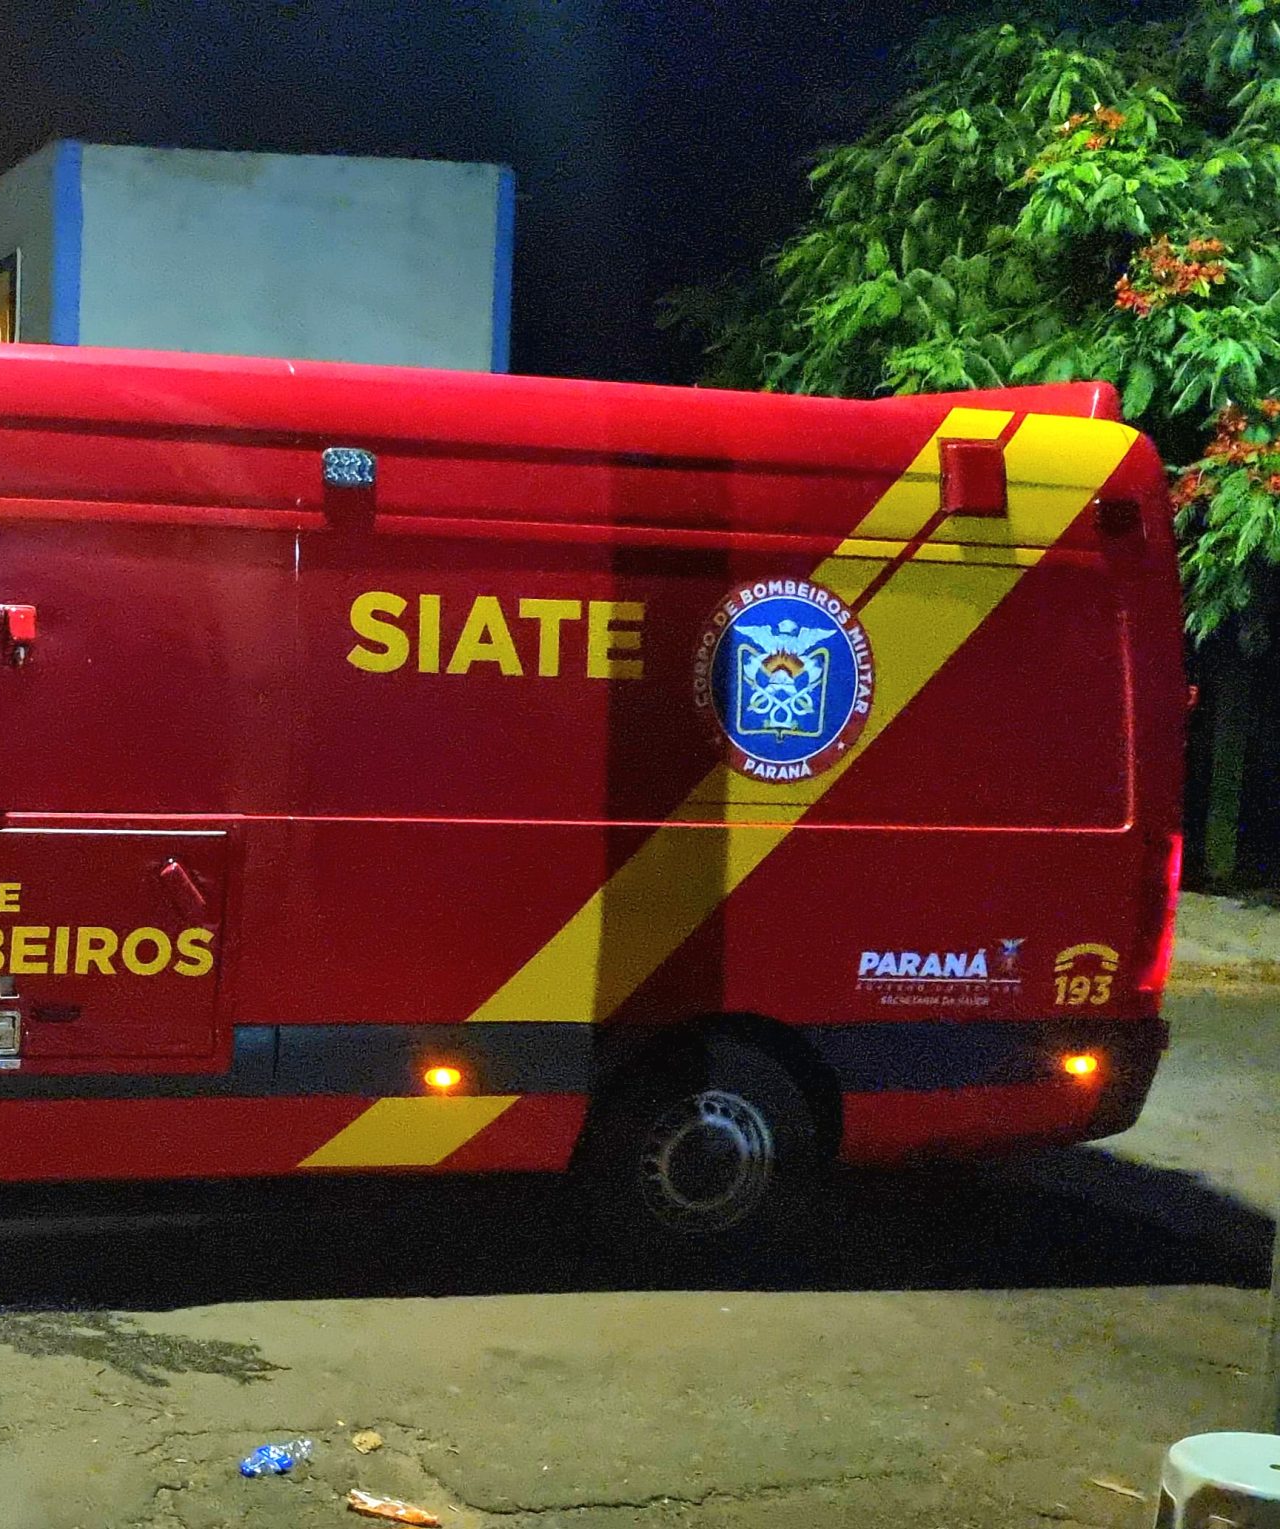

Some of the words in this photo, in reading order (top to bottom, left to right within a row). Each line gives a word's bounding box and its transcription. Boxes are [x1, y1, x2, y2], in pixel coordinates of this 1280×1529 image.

[346, 591, 646, 679] SIATE
[714, 601, 738, 626] DE
[739, 580, 851, 625] BOMBEIROS
[847, 627, 874, 714] MILITAR
[743, 758, 812, 780] PARANÁ
[858, 949, 988, 978] PARANÁ
[1054, 975, 1113, 1005] 193
